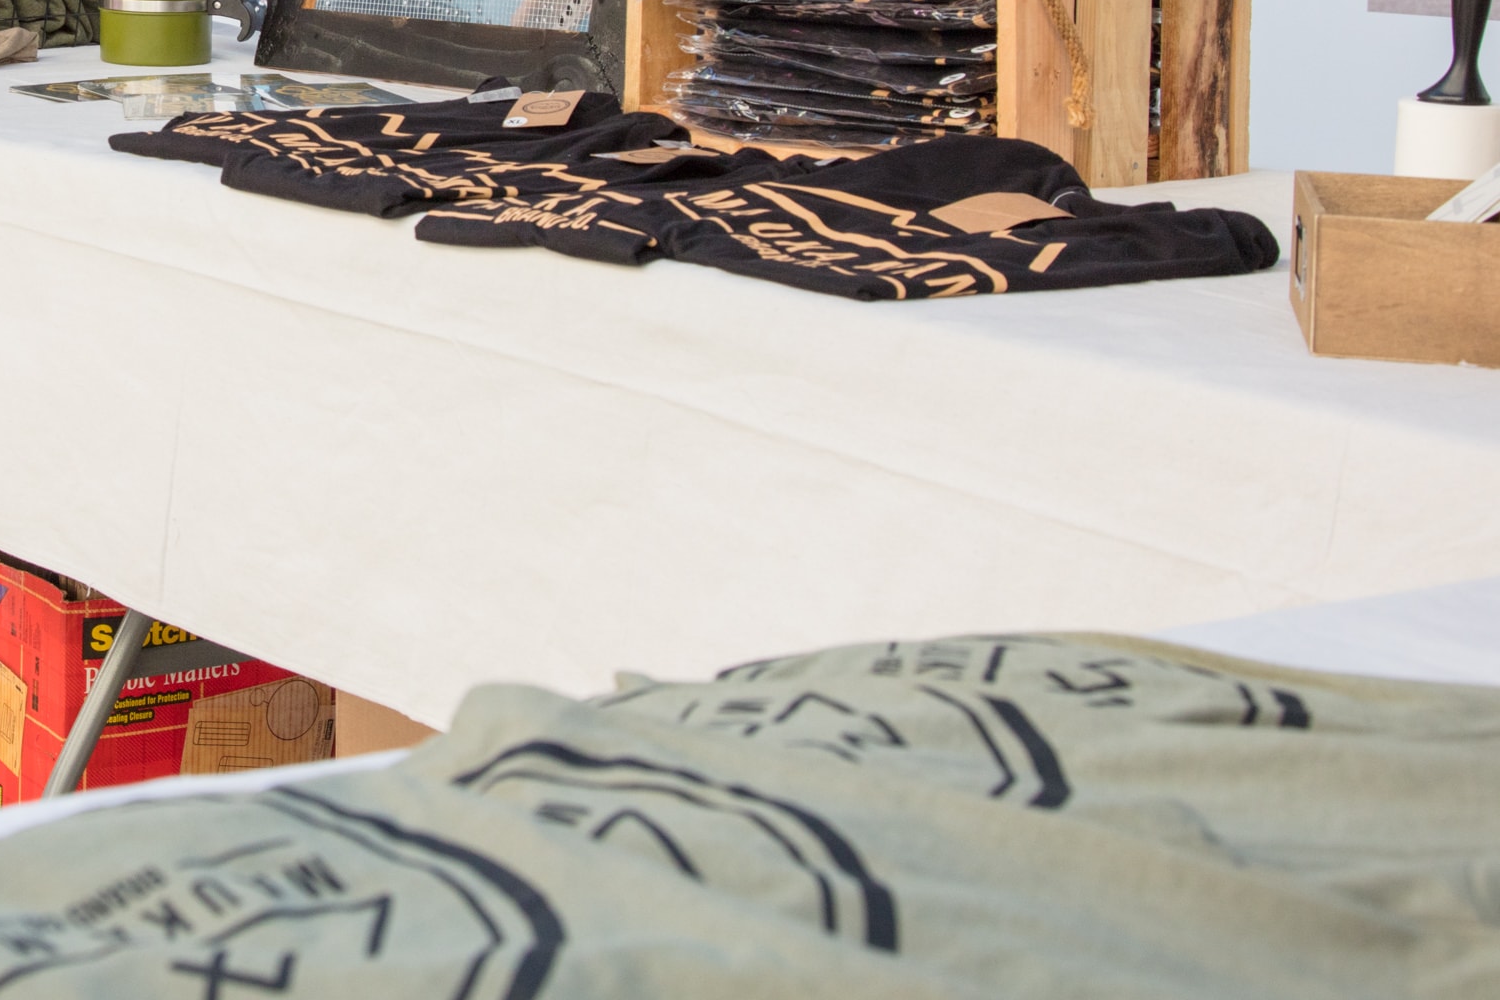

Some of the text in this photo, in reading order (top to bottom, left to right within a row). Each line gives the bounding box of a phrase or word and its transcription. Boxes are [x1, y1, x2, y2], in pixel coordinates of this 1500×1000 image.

[687, 189, 861, 262] MAUKA
[90, 621, 197, 652] Stch
[114, 690, 190, 710] Cushioned for Protection
[107, 709, 153, 724] ealing Closure
